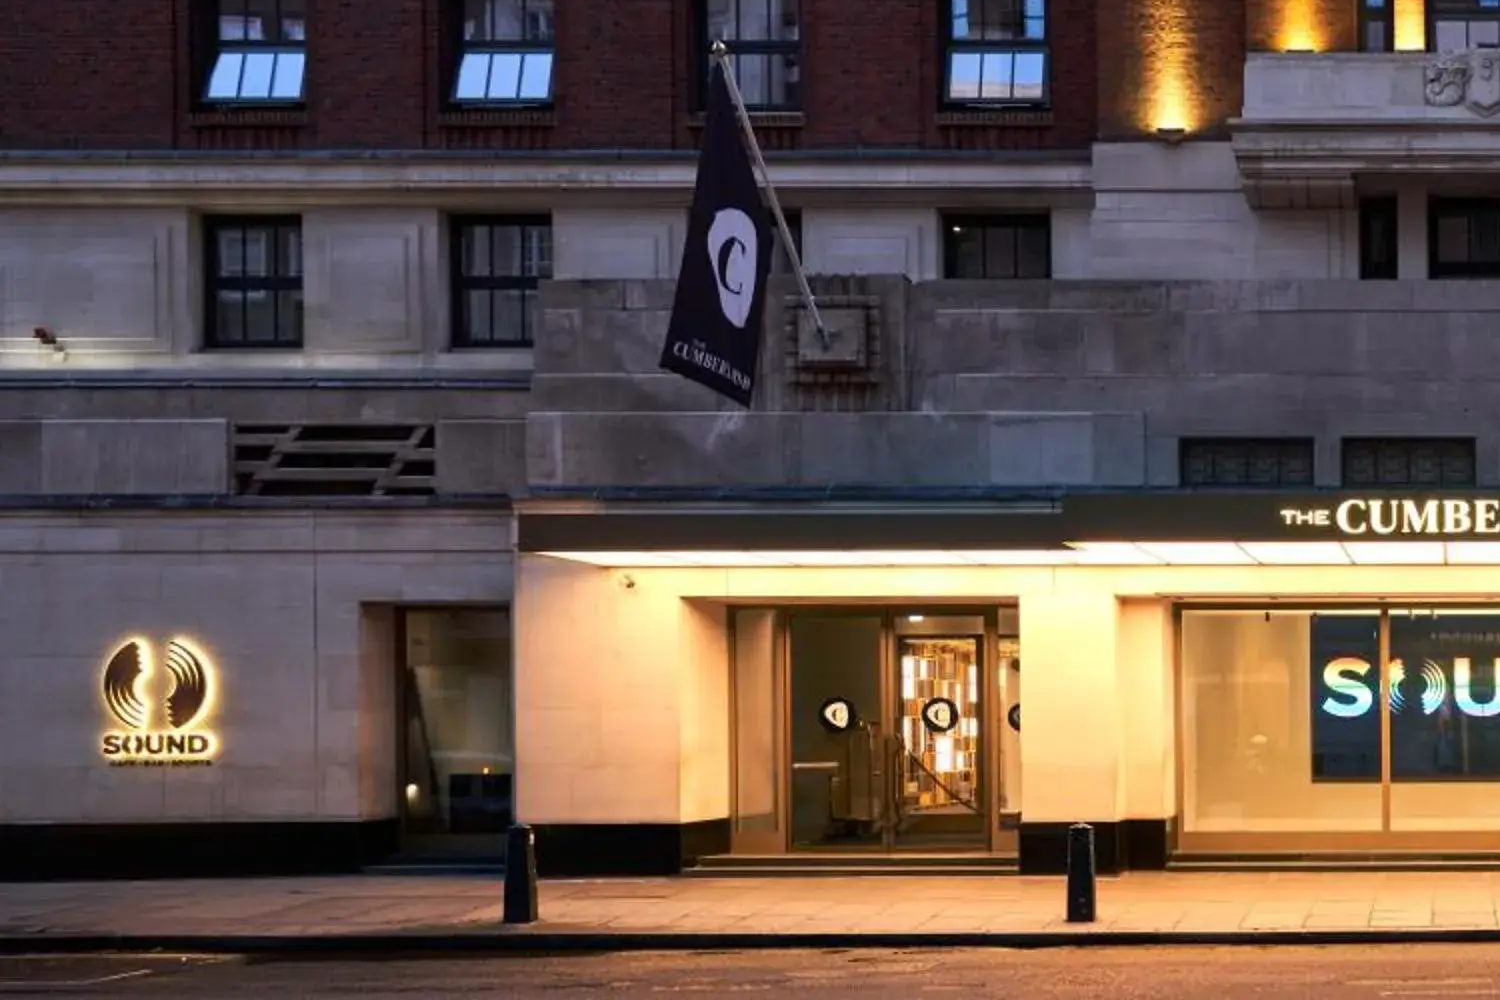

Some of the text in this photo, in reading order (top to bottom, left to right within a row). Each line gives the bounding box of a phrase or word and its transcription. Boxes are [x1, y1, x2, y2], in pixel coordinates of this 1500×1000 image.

[717, 236, 746, 295] C
[1280, 509, 1329, 526] THE
[103, 735, 209, 755] SOUND
